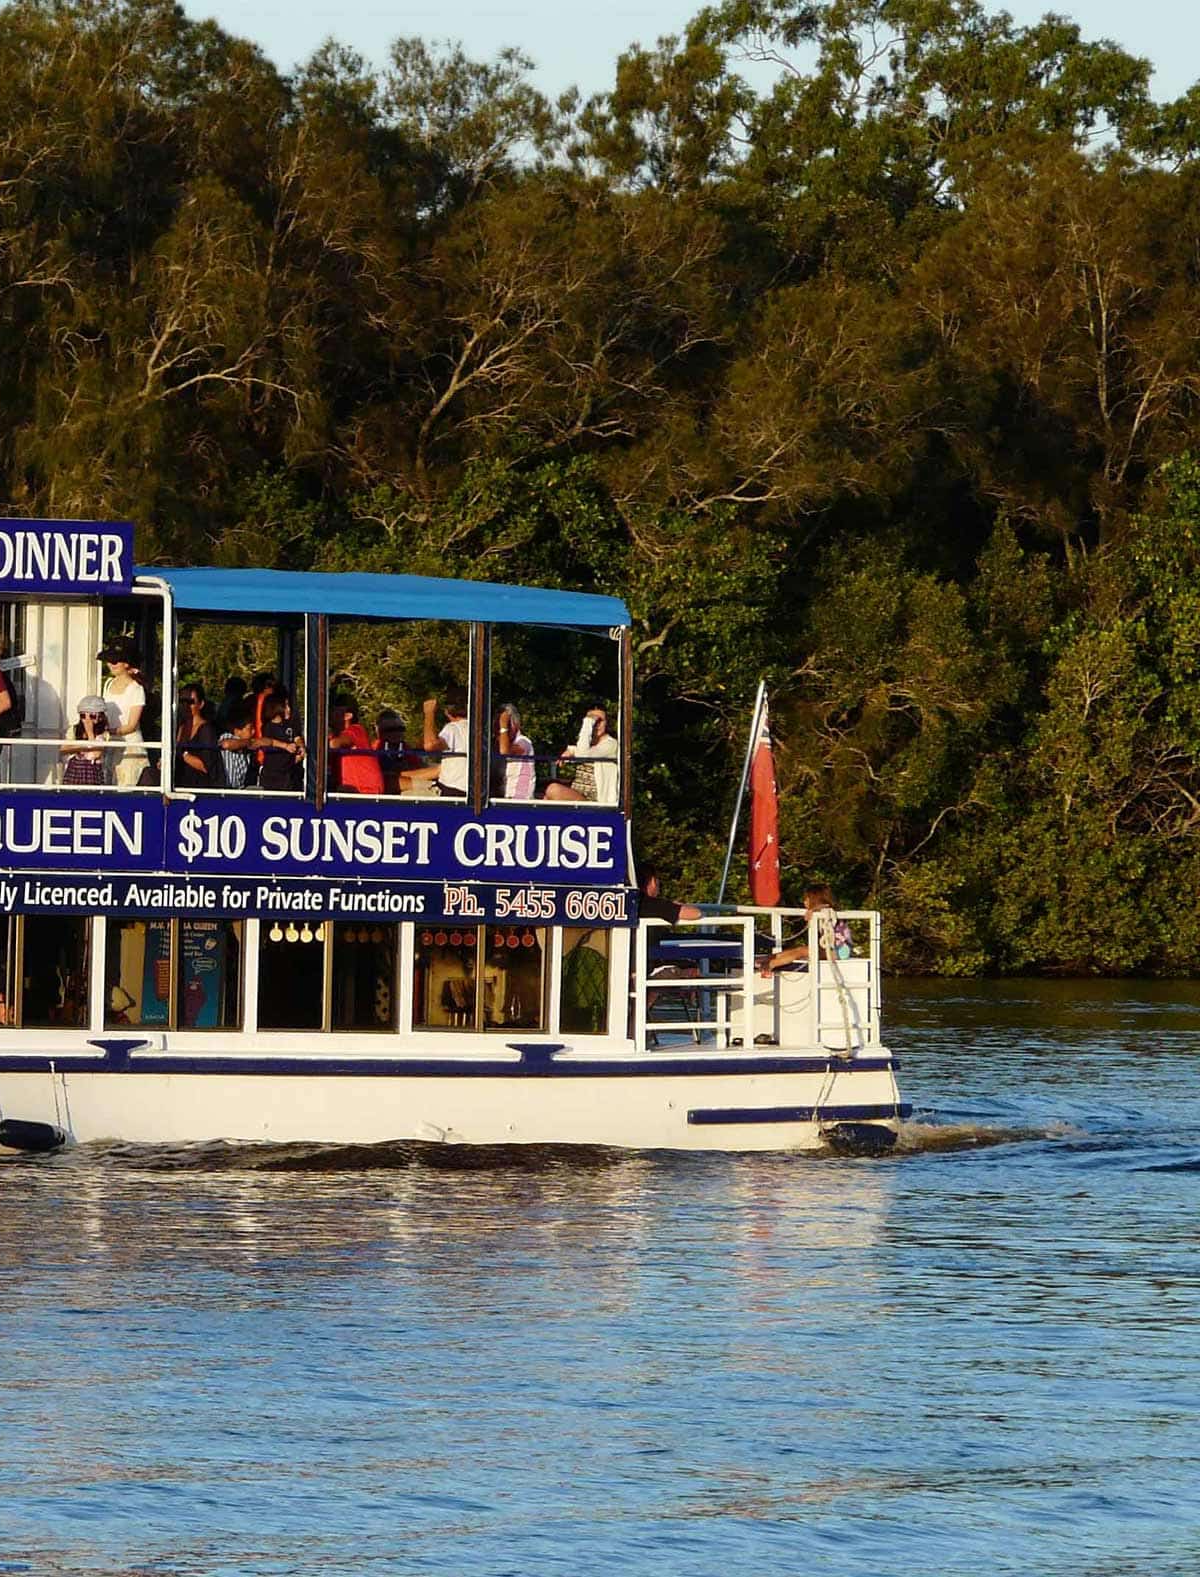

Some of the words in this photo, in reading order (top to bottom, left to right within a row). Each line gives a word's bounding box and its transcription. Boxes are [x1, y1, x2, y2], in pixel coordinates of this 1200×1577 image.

[178, 808, 246, 863] $10
[260, 816, 438, 865] SUNSET
[454, 822, 614, 869] CRUISE
[23, 881, 118, 906] Licenced.
[124, 883, 216, 909] Available
[221, 885, 250, 909] for
[256, 886, 323, 911] Private
[329, 888, 425, 913] Functions
[443, 886, 485, 916] Ph.
[495, 888, 556, 918] 5455
[565, 891, 628, 921] 6661
